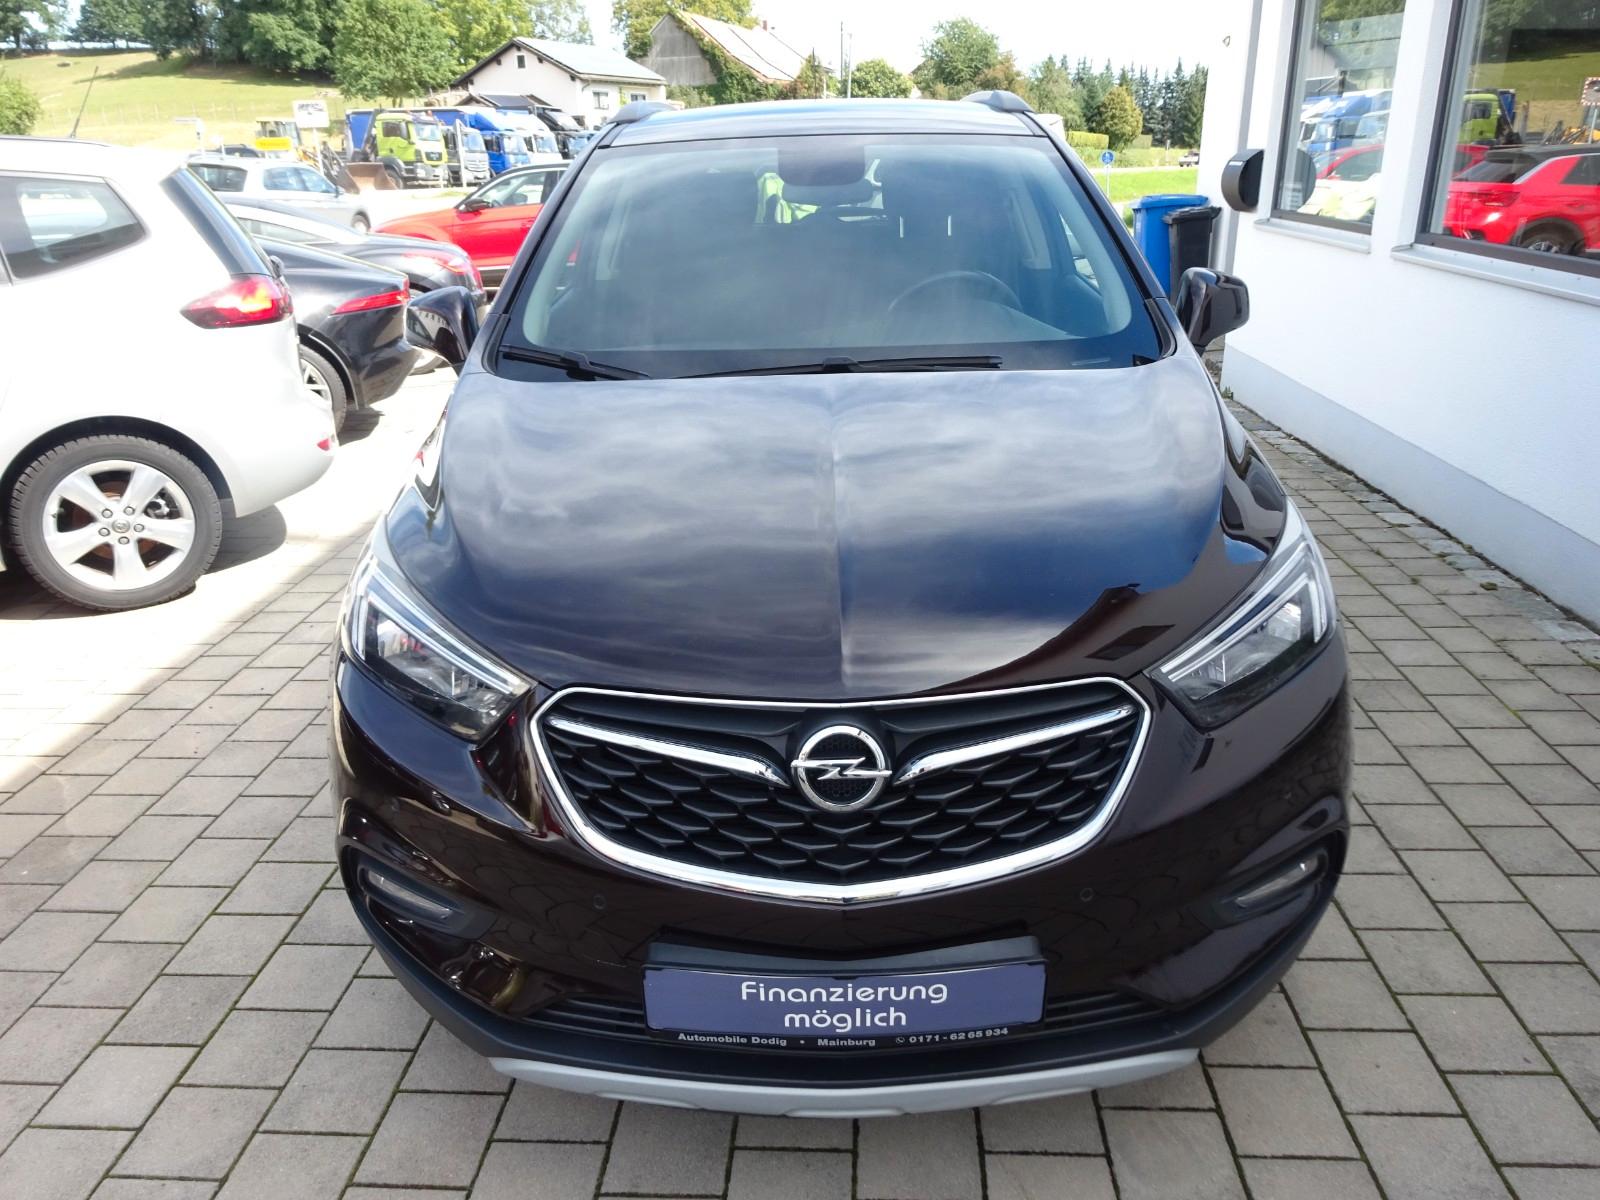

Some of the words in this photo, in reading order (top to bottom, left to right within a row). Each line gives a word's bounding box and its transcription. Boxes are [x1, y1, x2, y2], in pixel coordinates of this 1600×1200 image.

[741, 981, 948, 1004] Finanzierung
[783, 1007, 907, 1033] möglich
[678, 1033, 747, 1043] Automobile
[751, 1036, 787, 1046] Dodig
[817, 1039, 876, 1047] Mainburg
[909, 1035, 940, 1043] 0171
